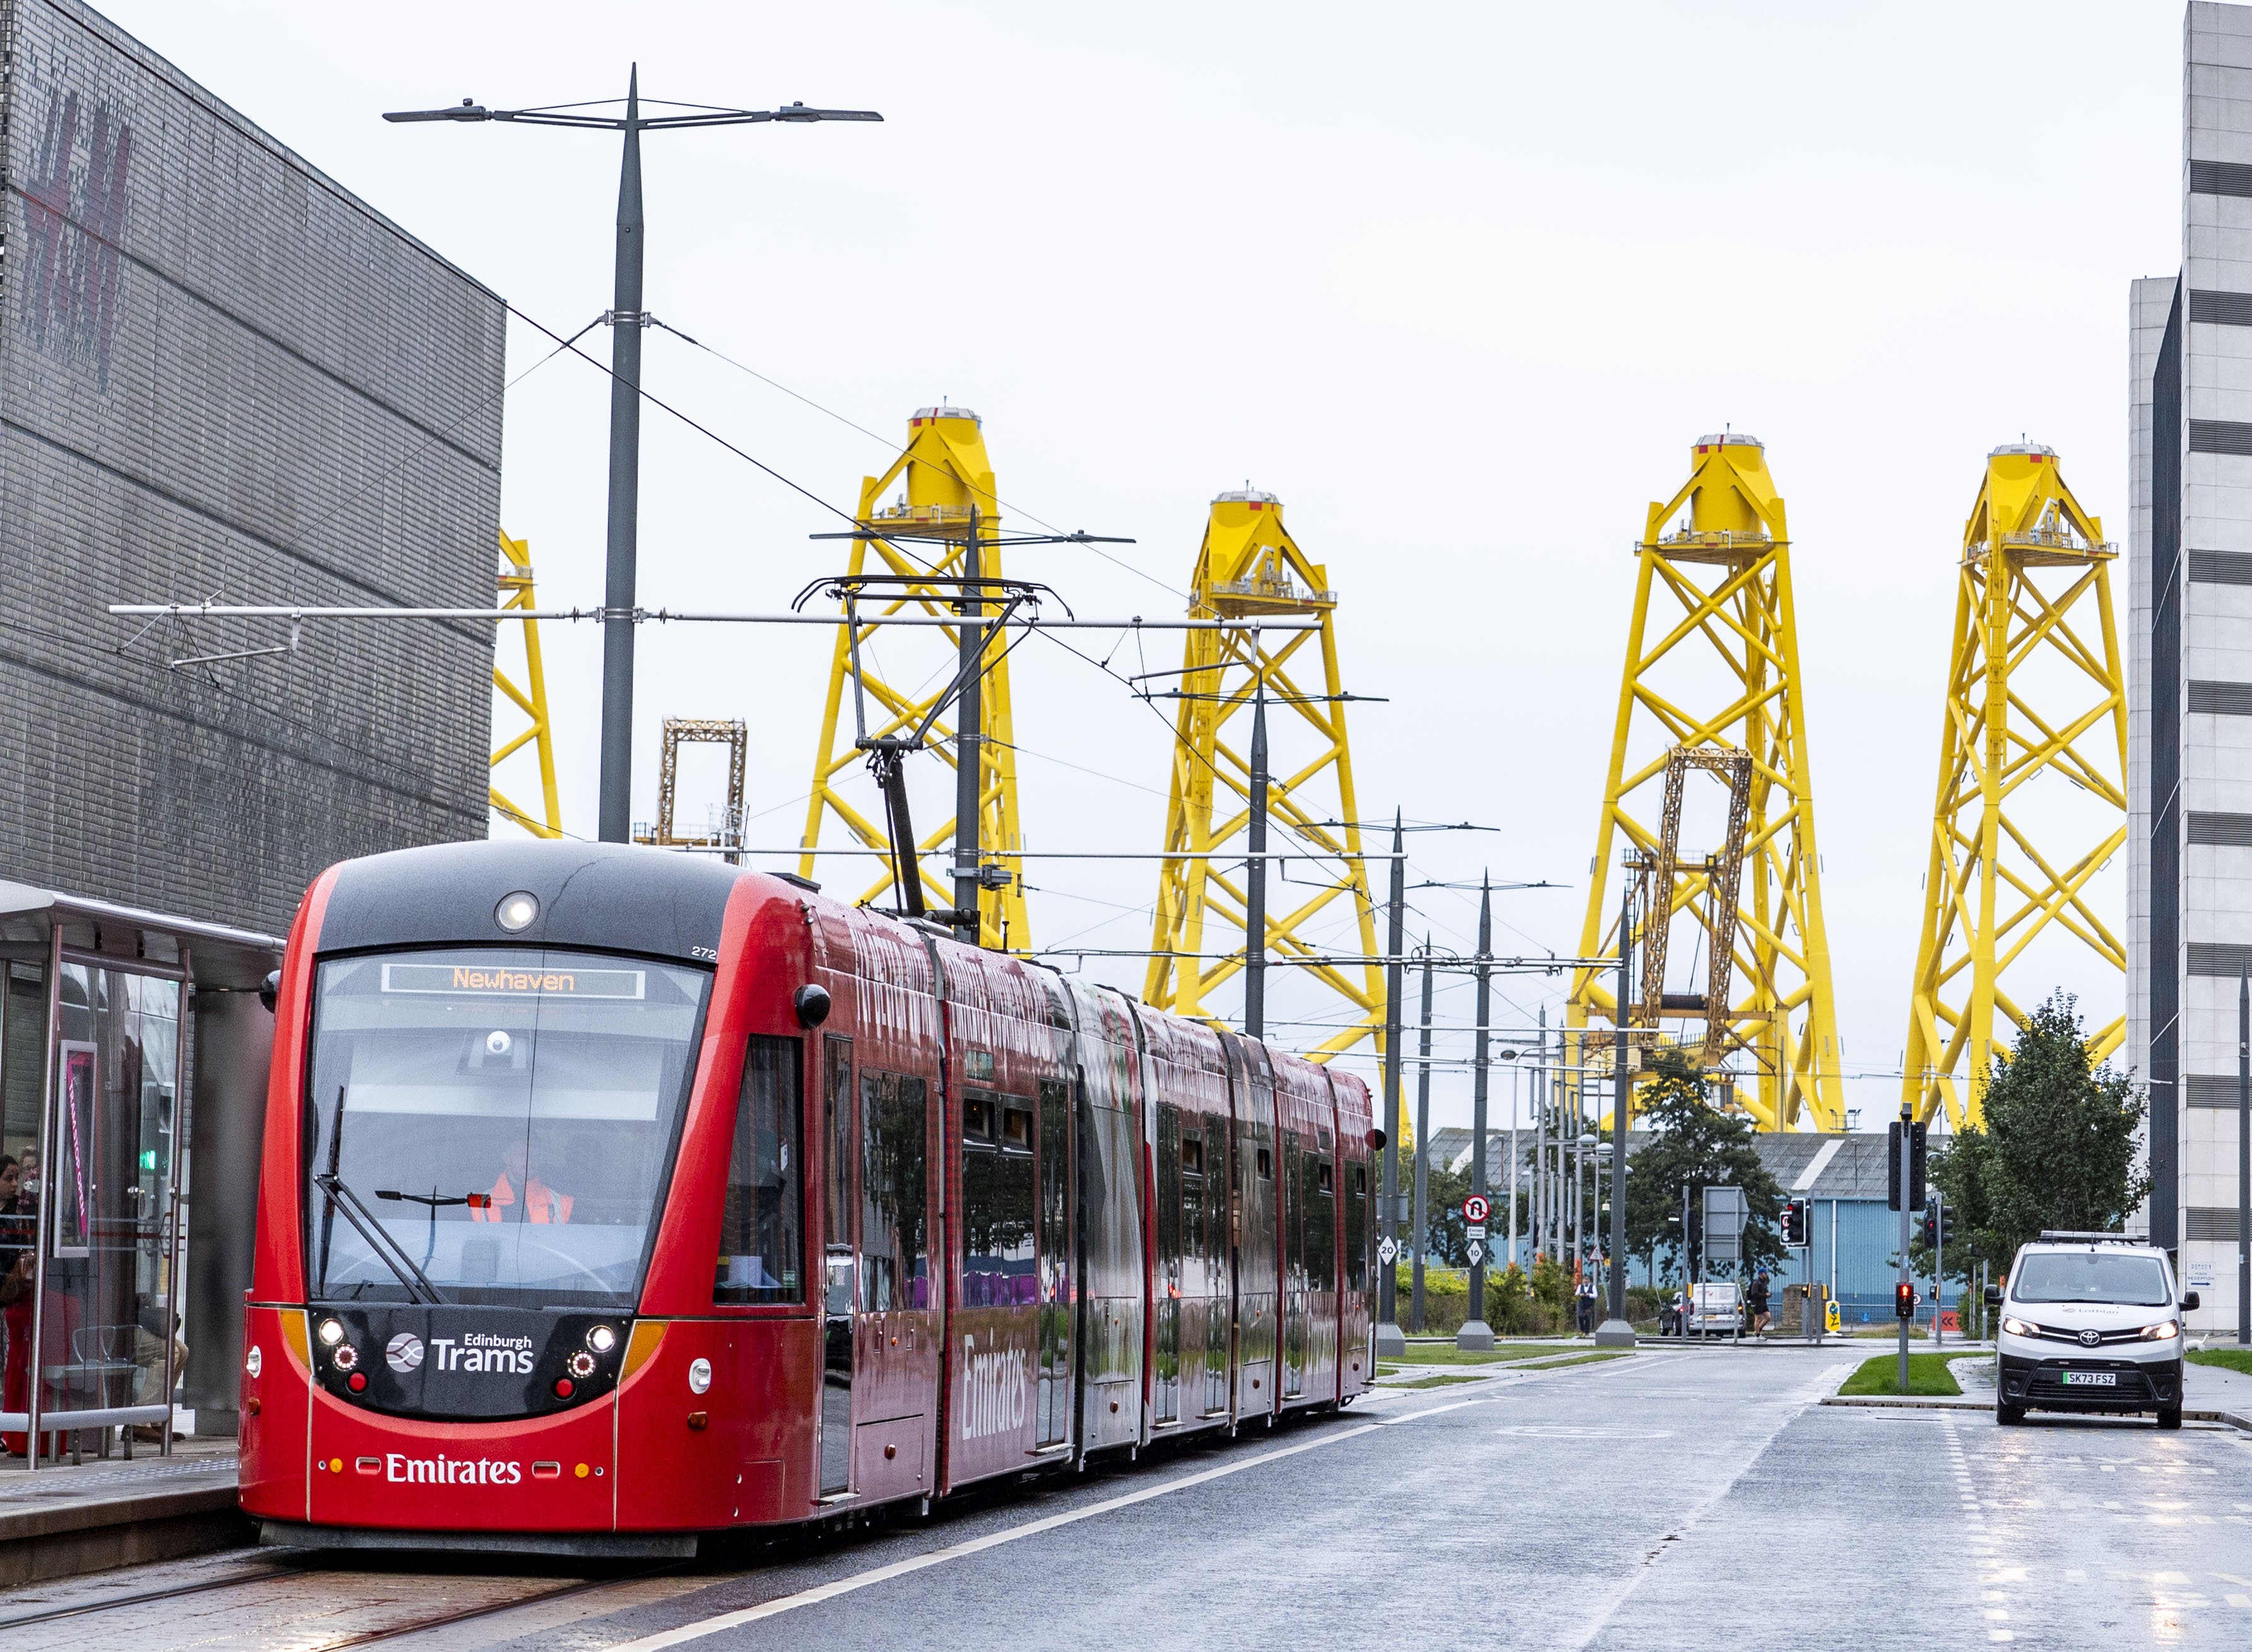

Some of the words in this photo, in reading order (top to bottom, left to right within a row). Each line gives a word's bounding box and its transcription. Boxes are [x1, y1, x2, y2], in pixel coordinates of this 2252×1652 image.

[691, 946, 717, 959] 272
[453, 968, 574, 991] Newhaven
[68, 1079, 76, 1128] TRAM
[76, 1171, 85, 1217] OPEN
[464, 1333, 532, 1350] Edinburgh
[431, 1339, 534, 1374] Trams
[962, 1327, 1026, 1441] Emirates
[2069, 1374, 2093, 1383] SK73
[2096, 1374, 2114, 1384] FSZ
[386, 1453, 521, 1484] Emirates
